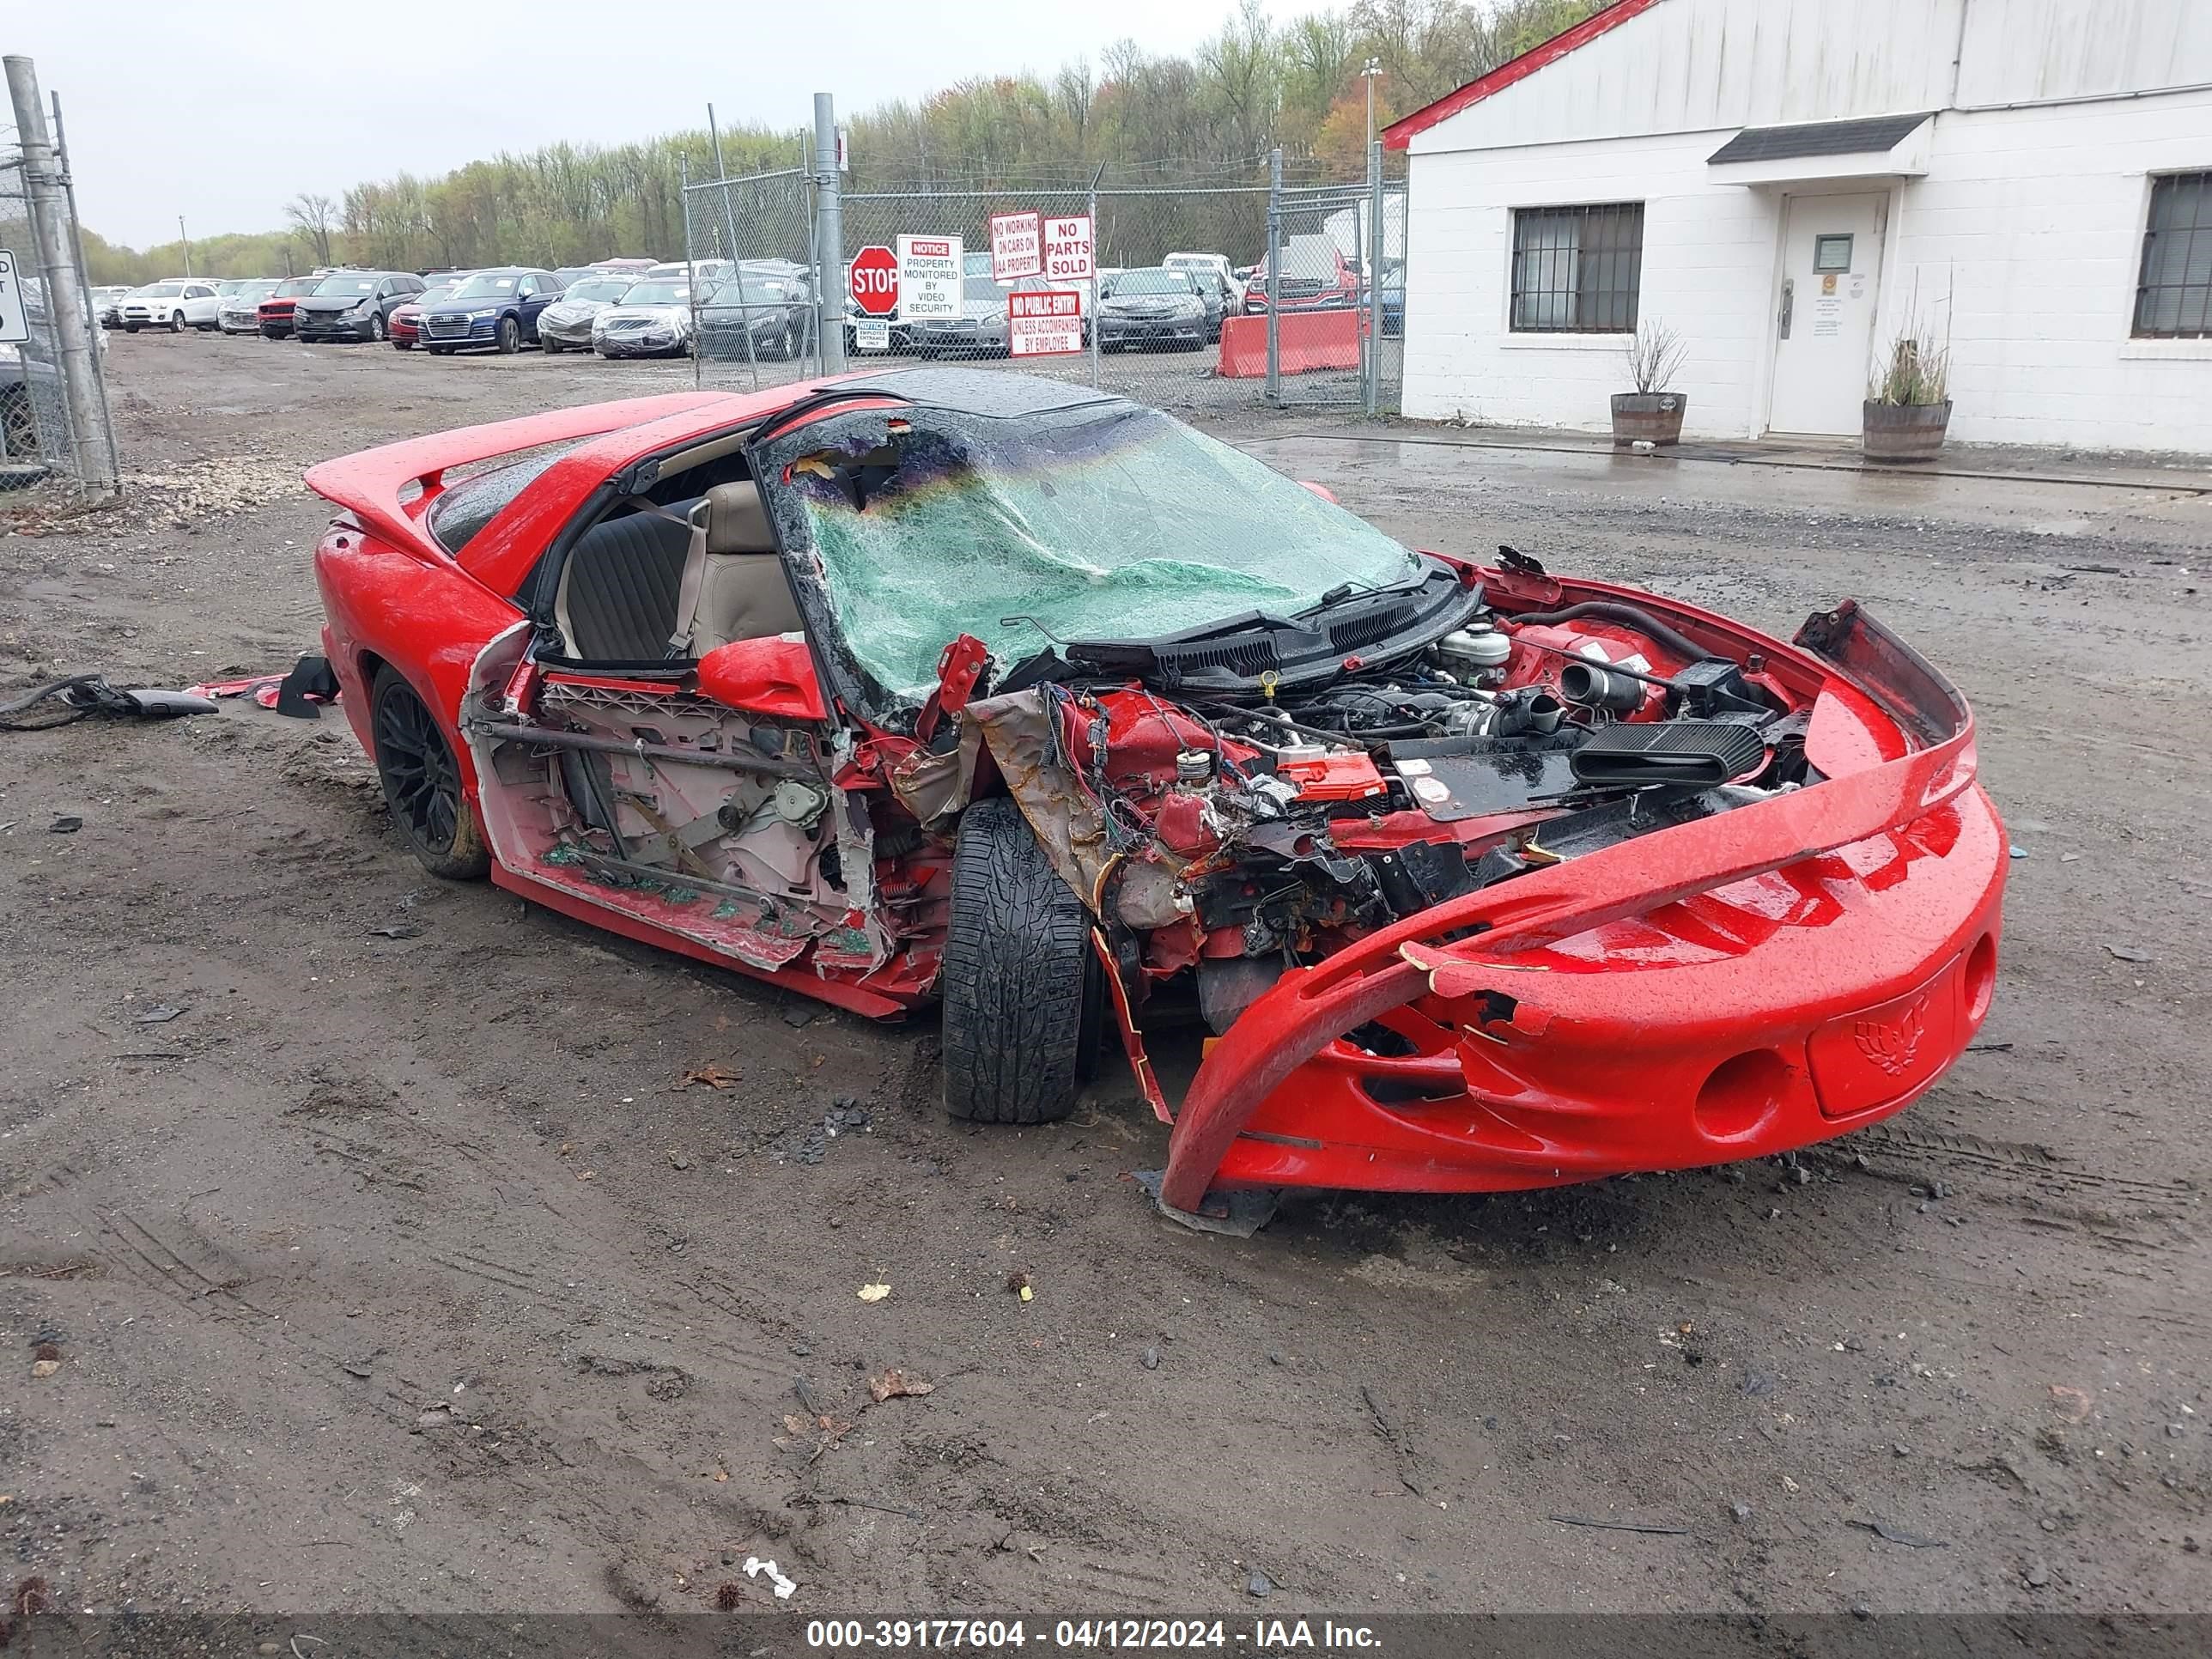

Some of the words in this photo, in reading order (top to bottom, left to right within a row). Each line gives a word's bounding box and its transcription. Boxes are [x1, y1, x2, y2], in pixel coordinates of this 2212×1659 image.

[994, 222, 1003, 237] NO
[1005, 217, 1037, 234] WORKING
[1058, 223, 1077, 237] NO
[913, 243, 948, 254] NOTICE
[999, 240, 1006, 254] ON
[1008, 238, 1024, 253] CARS
[1025, 236, 1034, 251] ON
[1047, 240, 1090, 256] PARTS
[907, 258, 955, 268] PROPERTY
[996, 258, 1006, 274] IAA
[1007, 255, 1038, 272] PROPERTY
[1052, 259, 1086, 275] SOLD
[854, 268, 898, 294] STOP
[904, 270, 957, 279] MONITORED
[918, 293, 945, 301] VIDEO
[909, 303, 953, 313] SECURITY
[1012, 296, 1024, 316] NO
[1024, 295, 1053, 315] PUBLIC
[1053, 295, 1077, 314] ENTRY
[860, 321, 886, 330] NOTICE
[1013, 319, 1036, 336] UNLESS
[1038, 318, 1079, 334] ACCOMPANIED
[1025, 337, 1033, 352] BY
[1036, 336, 1069, 351] EMPLOYEE
